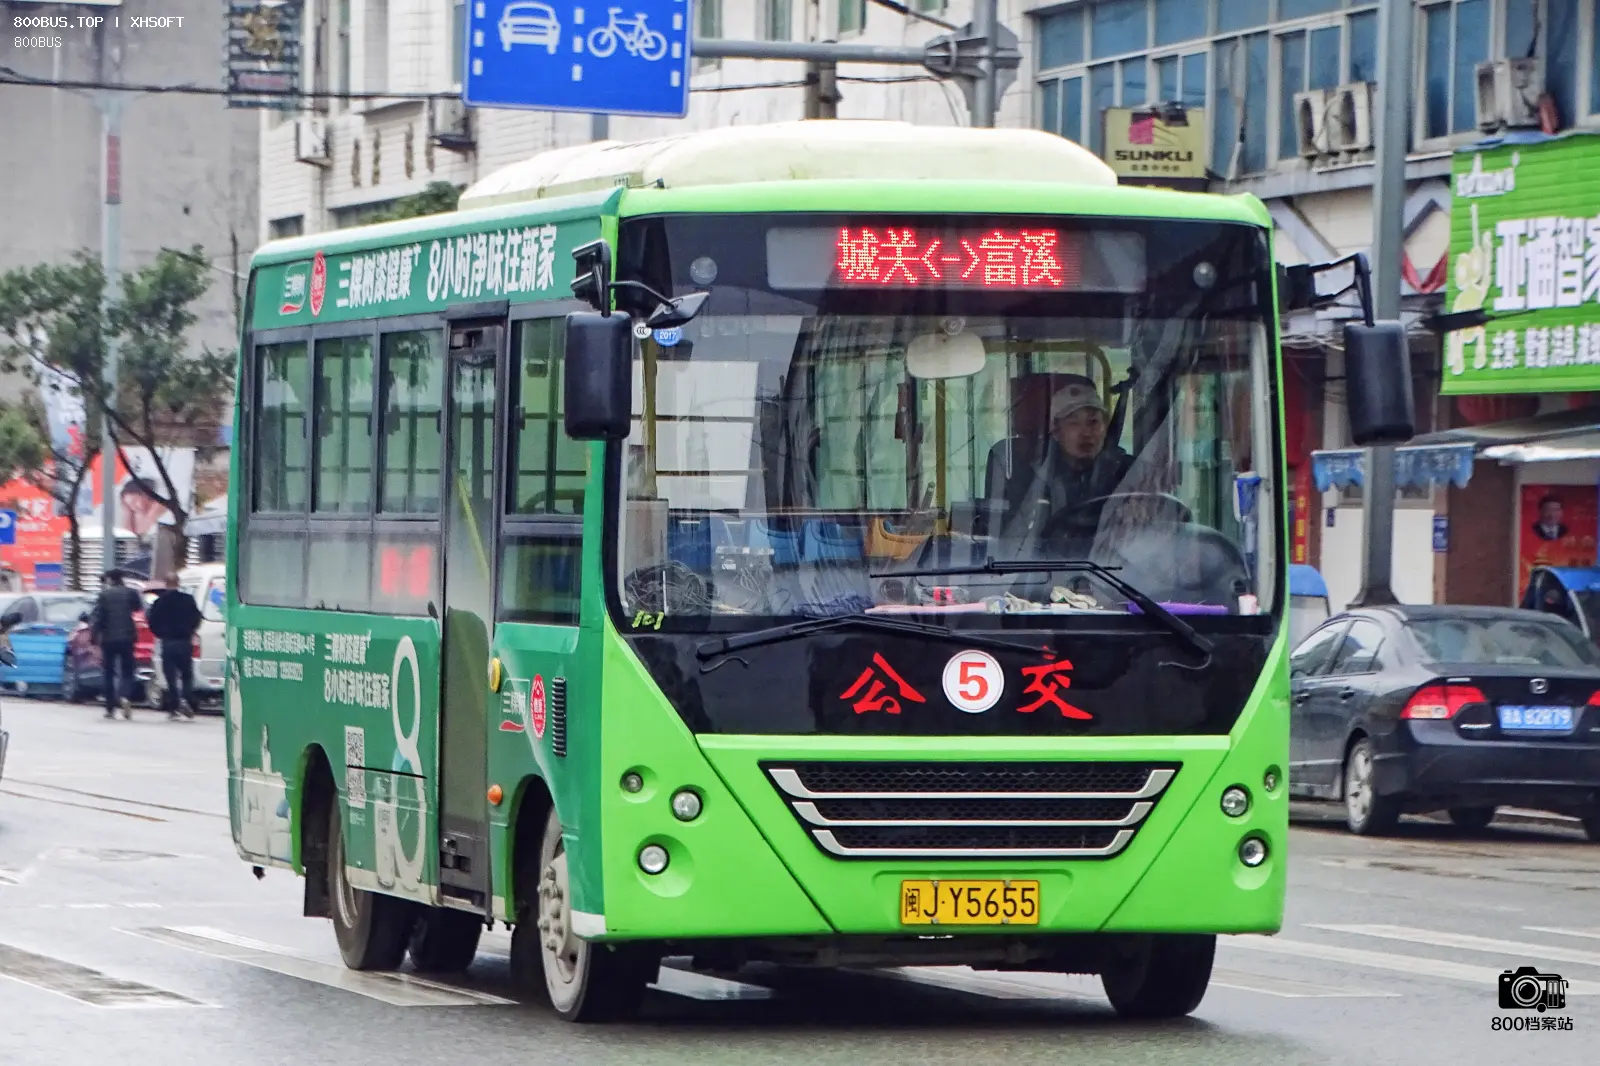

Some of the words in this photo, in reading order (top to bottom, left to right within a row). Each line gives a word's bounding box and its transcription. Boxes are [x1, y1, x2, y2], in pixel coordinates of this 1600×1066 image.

[427, 224, 557, 302] 8小时净味住新家
[660, 331, 677, 340] 2017
[839, 652, 926, 714] 公
[958, 661, 989, 701] 5
[1016, 645, 1093, 719] 交
